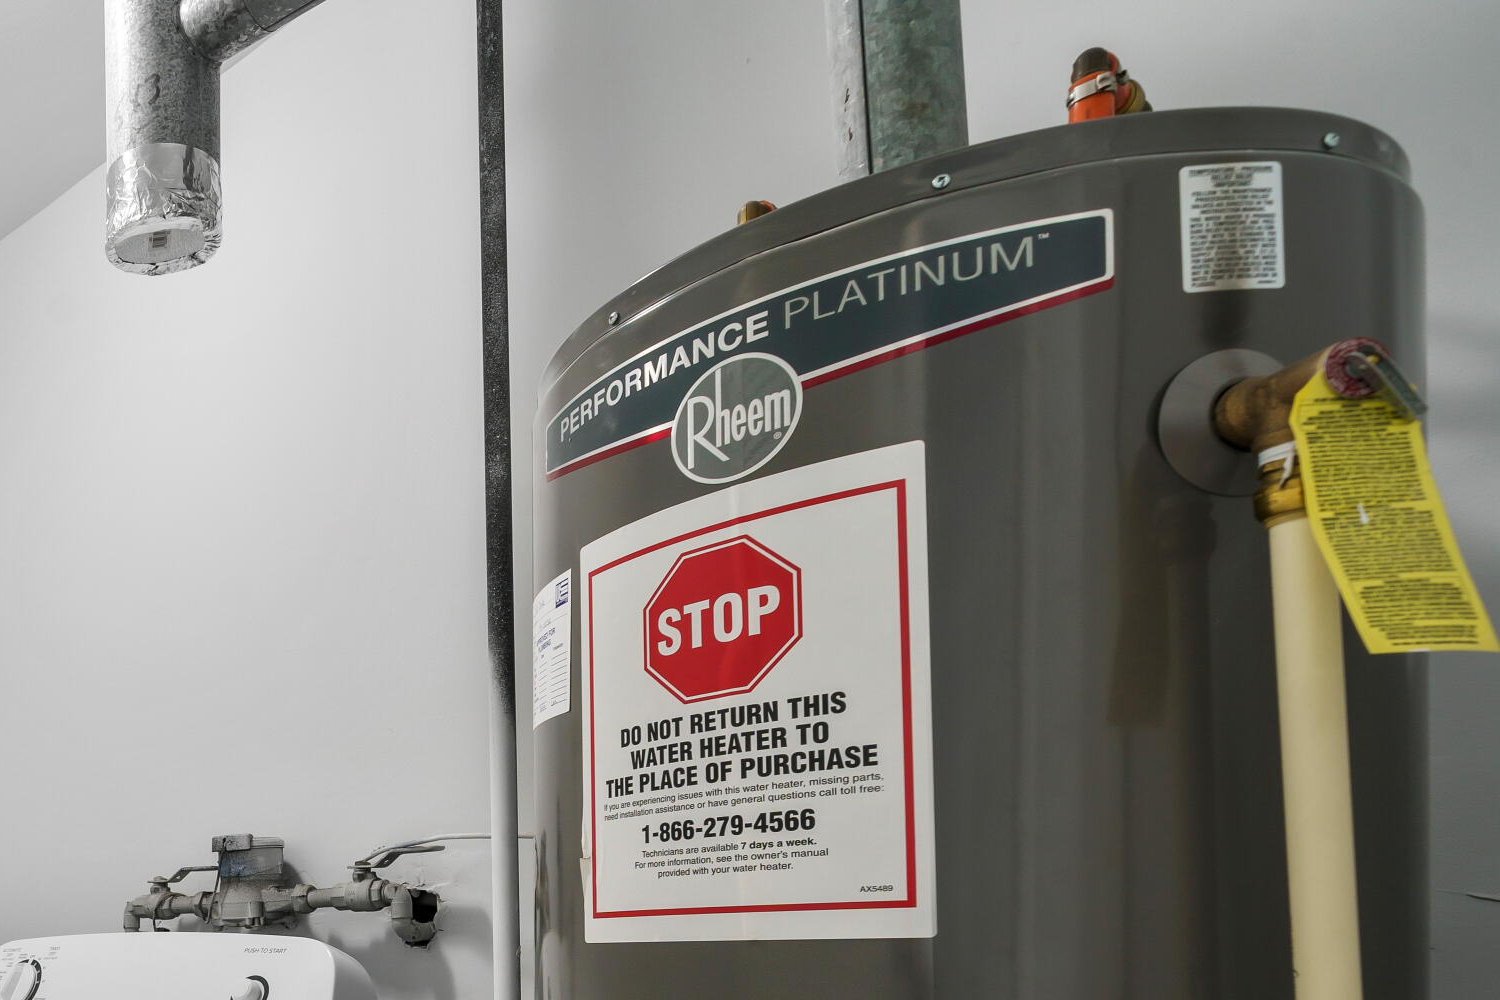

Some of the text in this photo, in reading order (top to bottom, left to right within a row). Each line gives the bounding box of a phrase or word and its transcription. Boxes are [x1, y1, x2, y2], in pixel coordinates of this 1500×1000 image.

[560, 310, 770, 442] PERFORMANCE
[658, 585, 780, 656] STOP
[621, 692, 846, 748] DO NOT RETURN THIS
[631, 722, 828, 770] WATER HEATER TO
[606, 744, 878, 798] THE PLACE OF PURCHASE
[604, 813, 618, 821] need
[620, 808, 654, 818] installation
[655, 803, 694, 814] assistance
[708, 799, 728, 808] have
[730, 794, 766, 806] general
[768, 791, 816, 802] questions
[819, 788, 837, 796] call
[840, 786, 856, 794] toll
[860, 784, 885, 794] free:
[608, 803, 620, 812] you
[632, 794, 676, 808] experiencing
[678, 791, 703, 800] issues
[705, 788, 722, 796] with
[725, 786, 740, 794] this
[742, 784, 769, 792] water
[772, 780, 806, 790] heater,
[809, 776, 850, 786] missing
[642, 808, 816, 844] 1-866-279-4566
[642, 848, 684, 858] Technicians
[701, 843, 738, 854] available
[749, 840, 774, 850] days
[786, 838, 817, 846] week.
[648, 860, 666, 868] more
[668, 857, 714, 867] information,
[750, 851, 788, 860] owner's
[790, 848, 828, 858] manual
[658, 862, 794, 879] provided with your water heater.
[860, 884, 894, 892] AX5489
